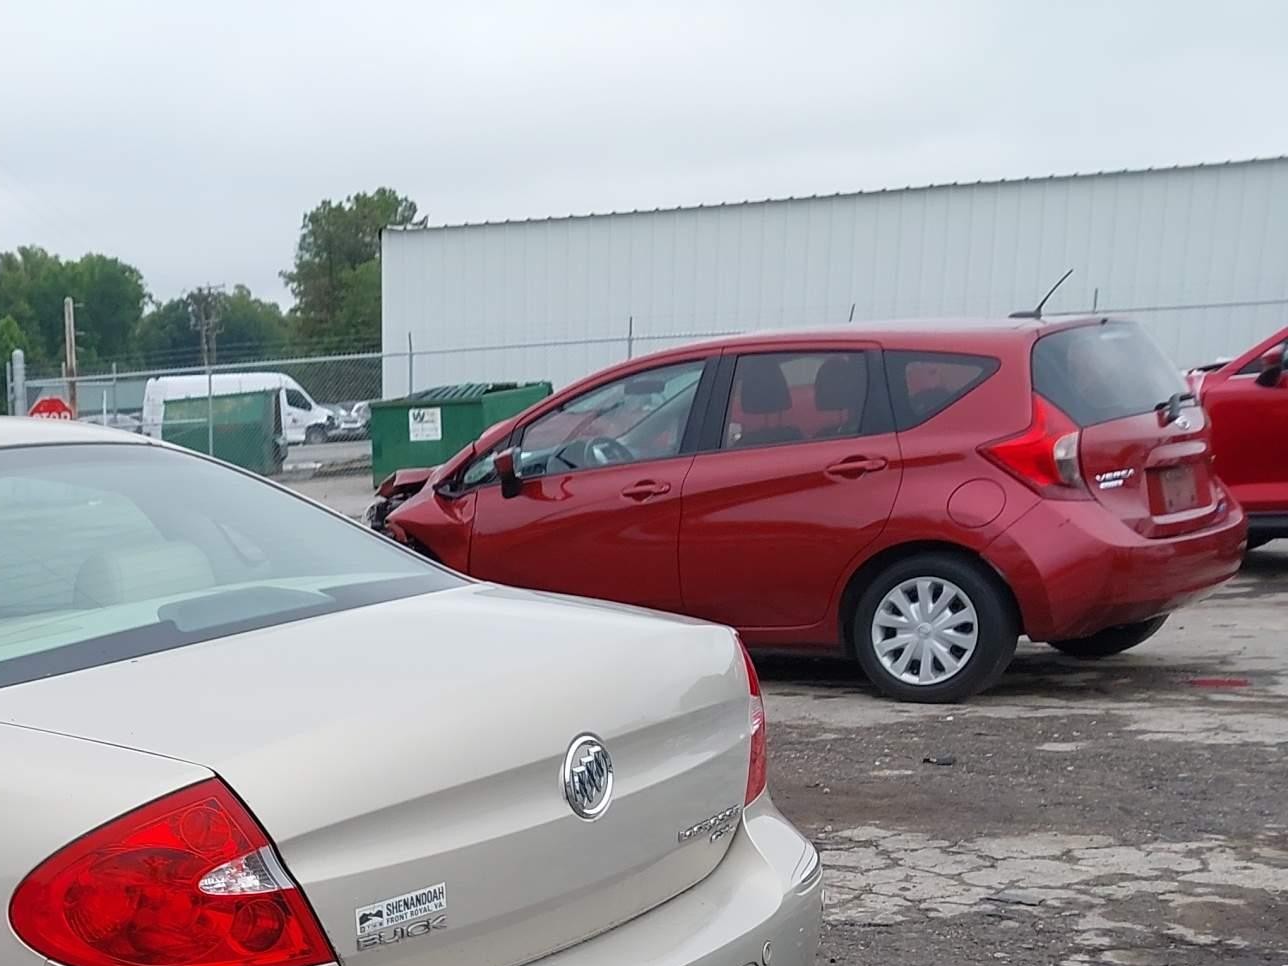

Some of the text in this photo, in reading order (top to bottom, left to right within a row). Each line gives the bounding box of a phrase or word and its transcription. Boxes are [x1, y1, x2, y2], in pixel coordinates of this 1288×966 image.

[385, 886, 445, 917] SHENANDOAH
[356, 914, 447, 952] BUICK
[385, 911, 409, 926] FRONT
